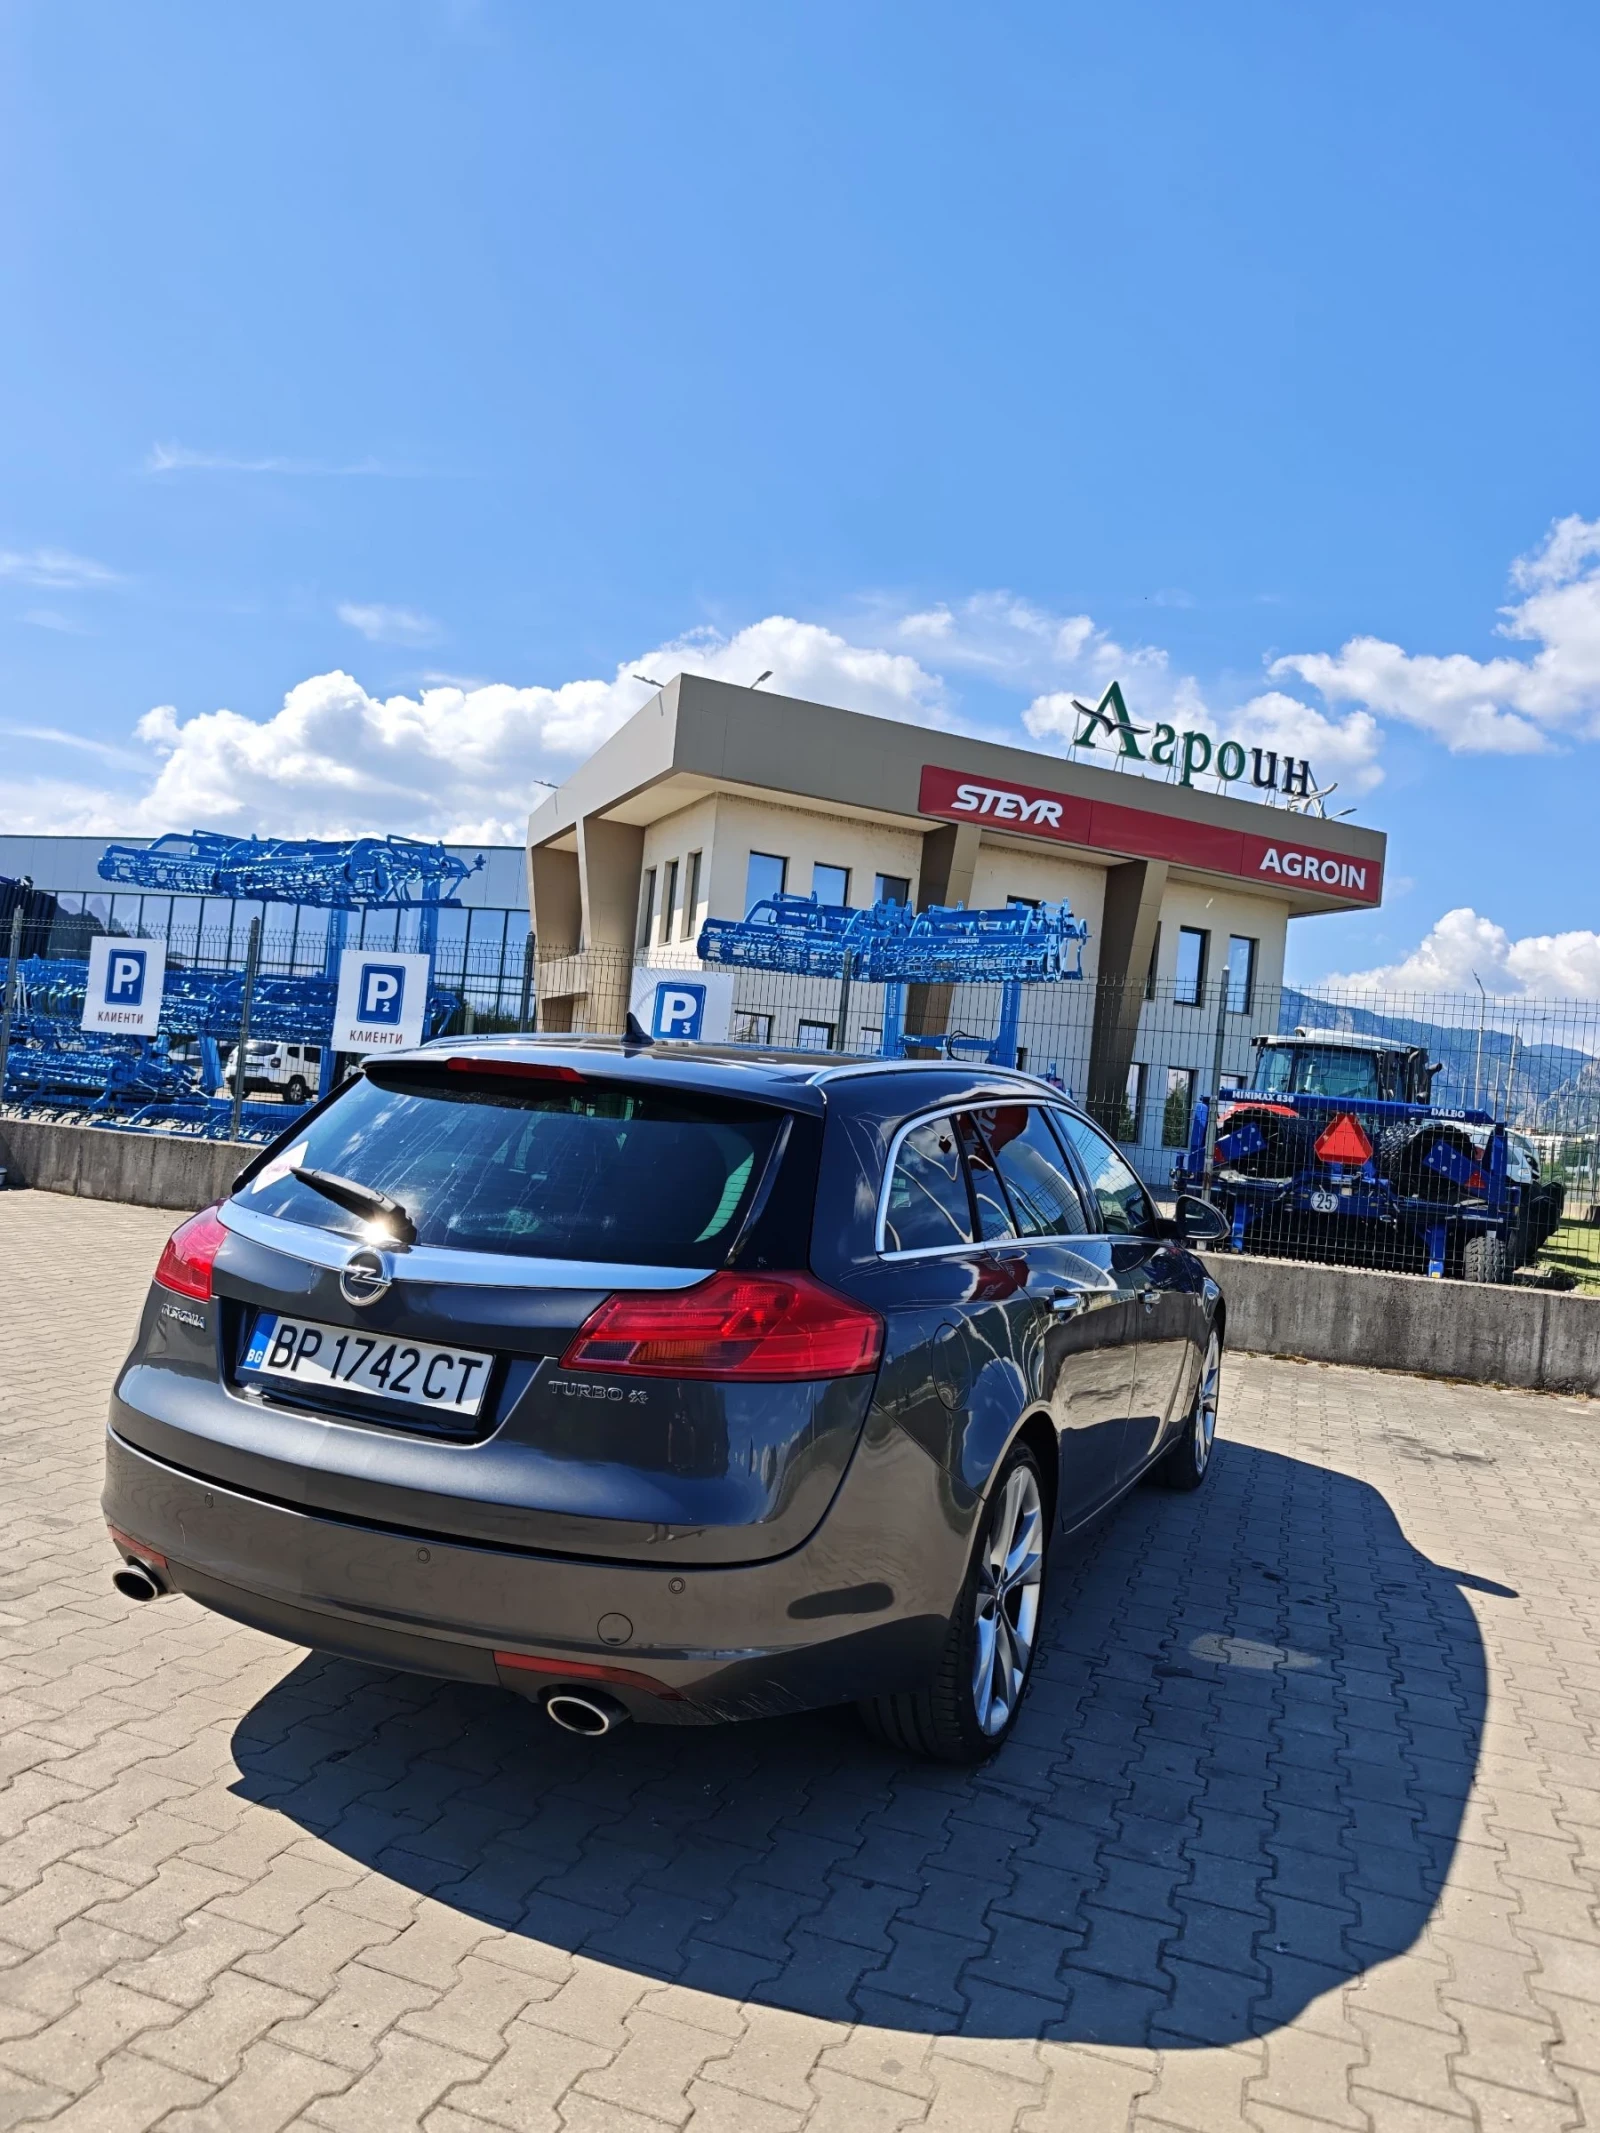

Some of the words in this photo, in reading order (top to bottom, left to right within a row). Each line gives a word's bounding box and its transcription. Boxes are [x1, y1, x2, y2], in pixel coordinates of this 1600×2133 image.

[1071, 680, 1310, 798] Агроин
[950, 784, 1063, 828] STEYR
[1259, 848, 1366, 891] AGROIN
[97, 1011, 144, 1025] КЛИЕНТИ
[349, 1029, 404, 1045] КЛИЕНТИ
[1232, 1090, 1275, 1102] MINIMAX
[1430, 1107, 1466, 1119] DALBO
[1316, 1193, 1333, 1210] 25
[246, 1348, 264, 1364] BG
[547, 1380, 624, 1401] TURBO
